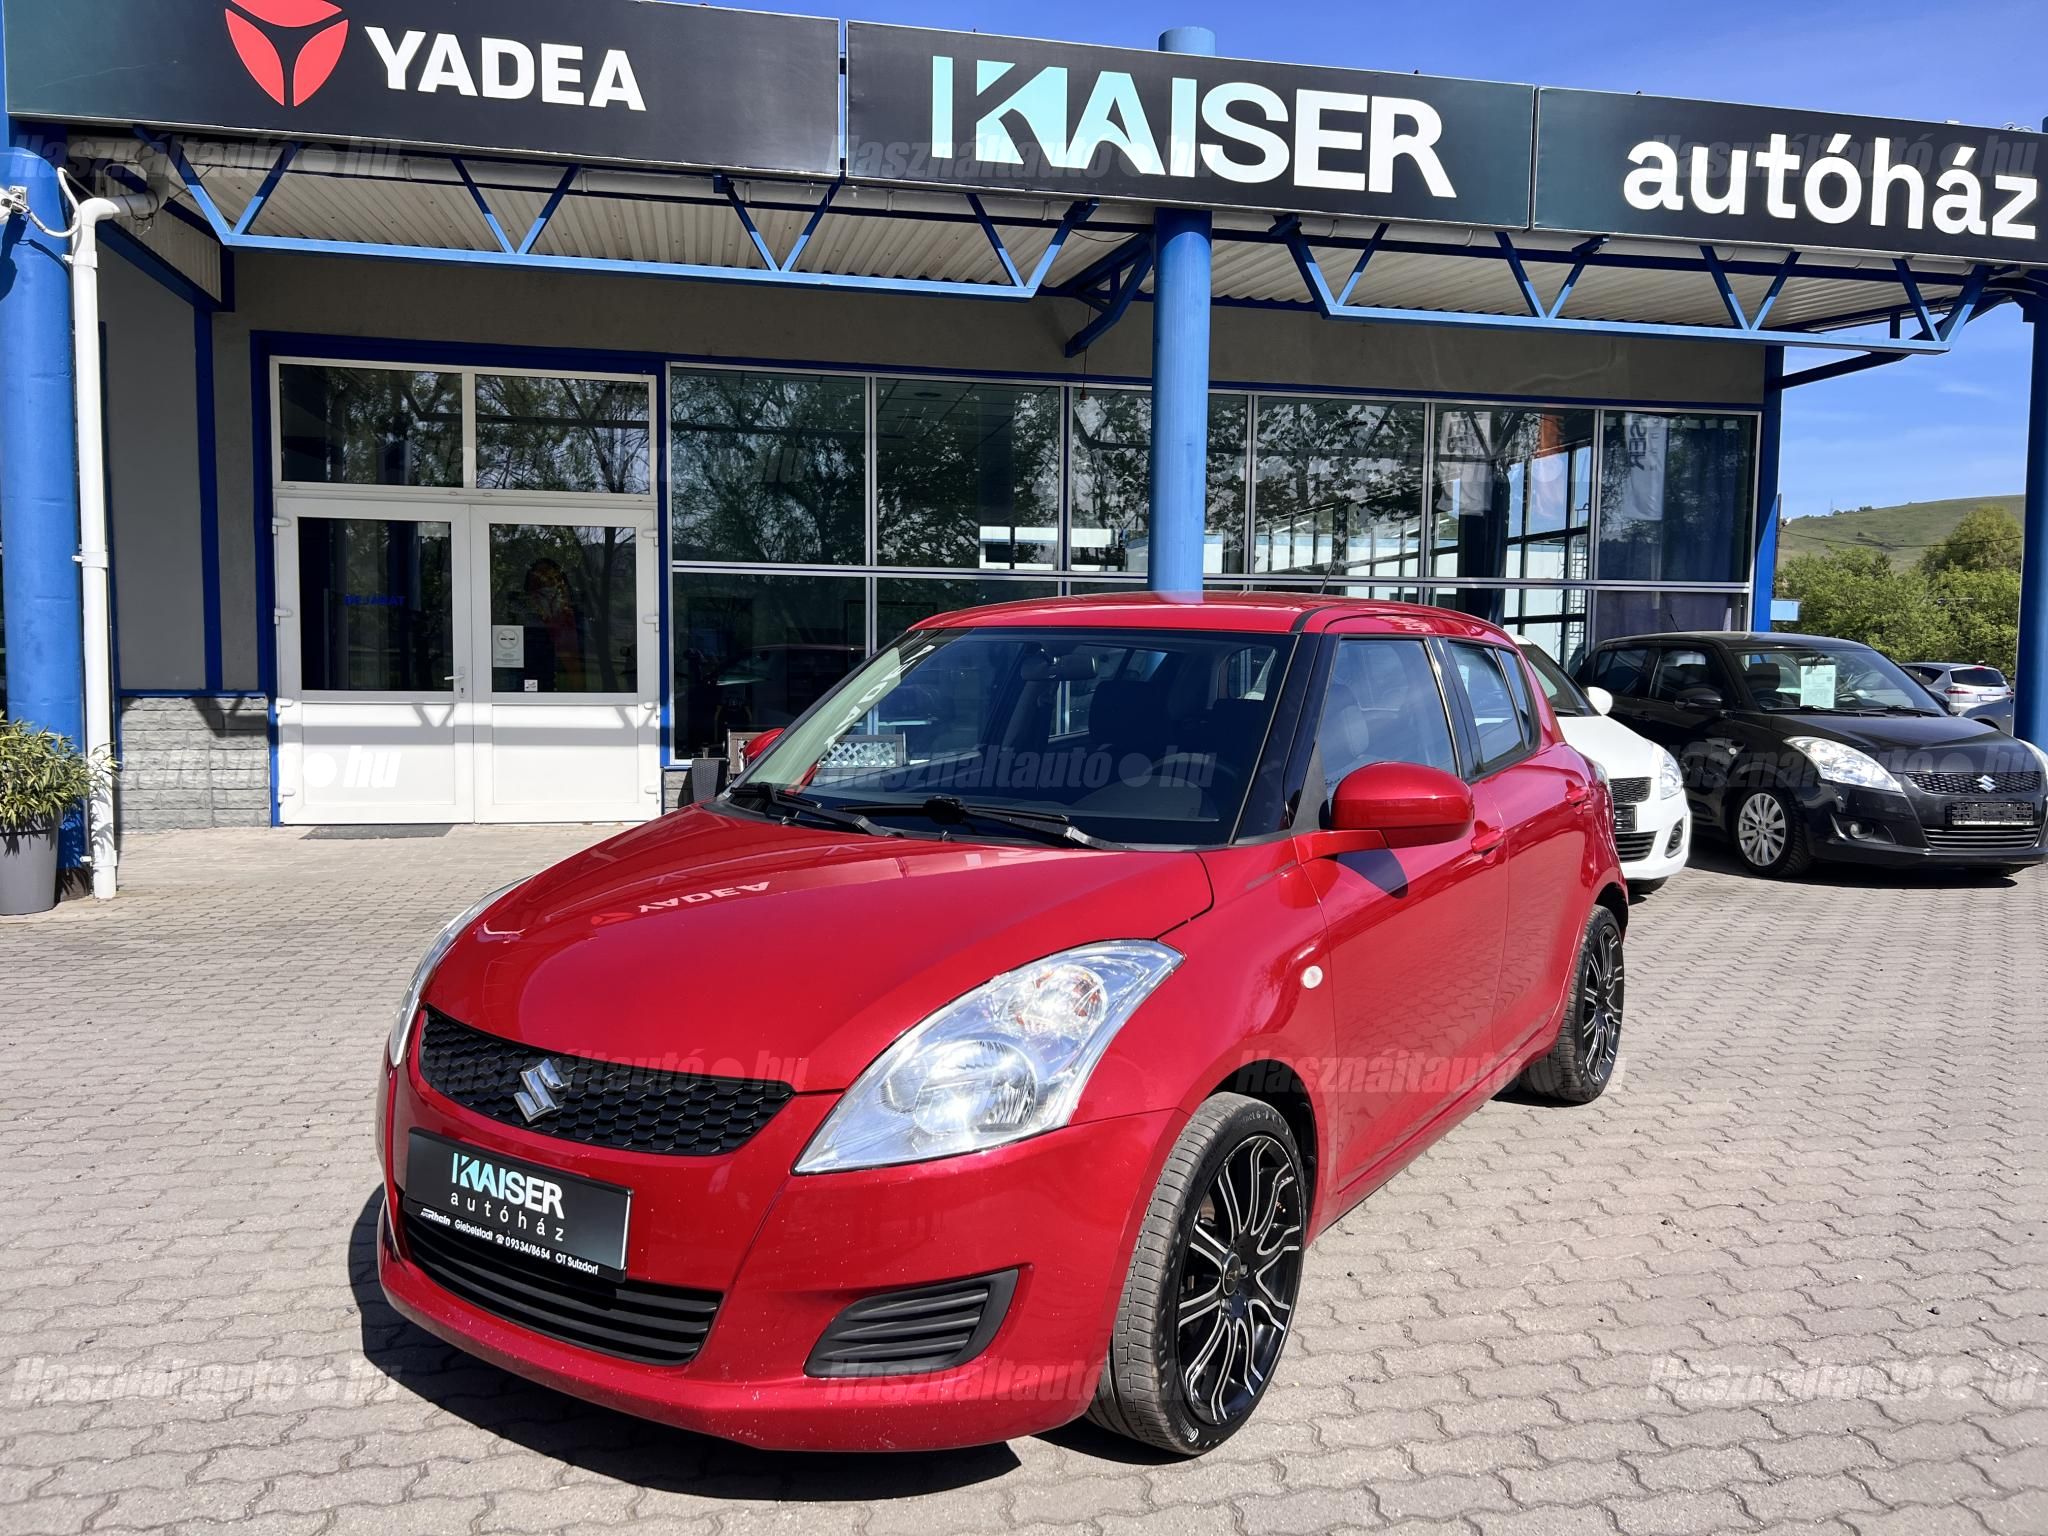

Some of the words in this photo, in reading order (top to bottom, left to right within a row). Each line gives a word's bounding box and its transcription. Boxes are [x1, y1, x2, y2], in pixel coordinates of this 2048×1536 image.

[364, 26, 647, 113] YADEA
[931, 55, 1458, 199] KAISER
[1622, 132, 2039, 241] autóház
[450, 1191, 564, 1241] autóház
[451, 1152, 565, 1219] KAISER
[454, 1219, 493, 1241] Giebelstadt
[505, 1236, 551, 1260] 09334/8654
[555, 1252, 567, 1265] OT
[567, 1256, 599, 1275] Sulzdorf
